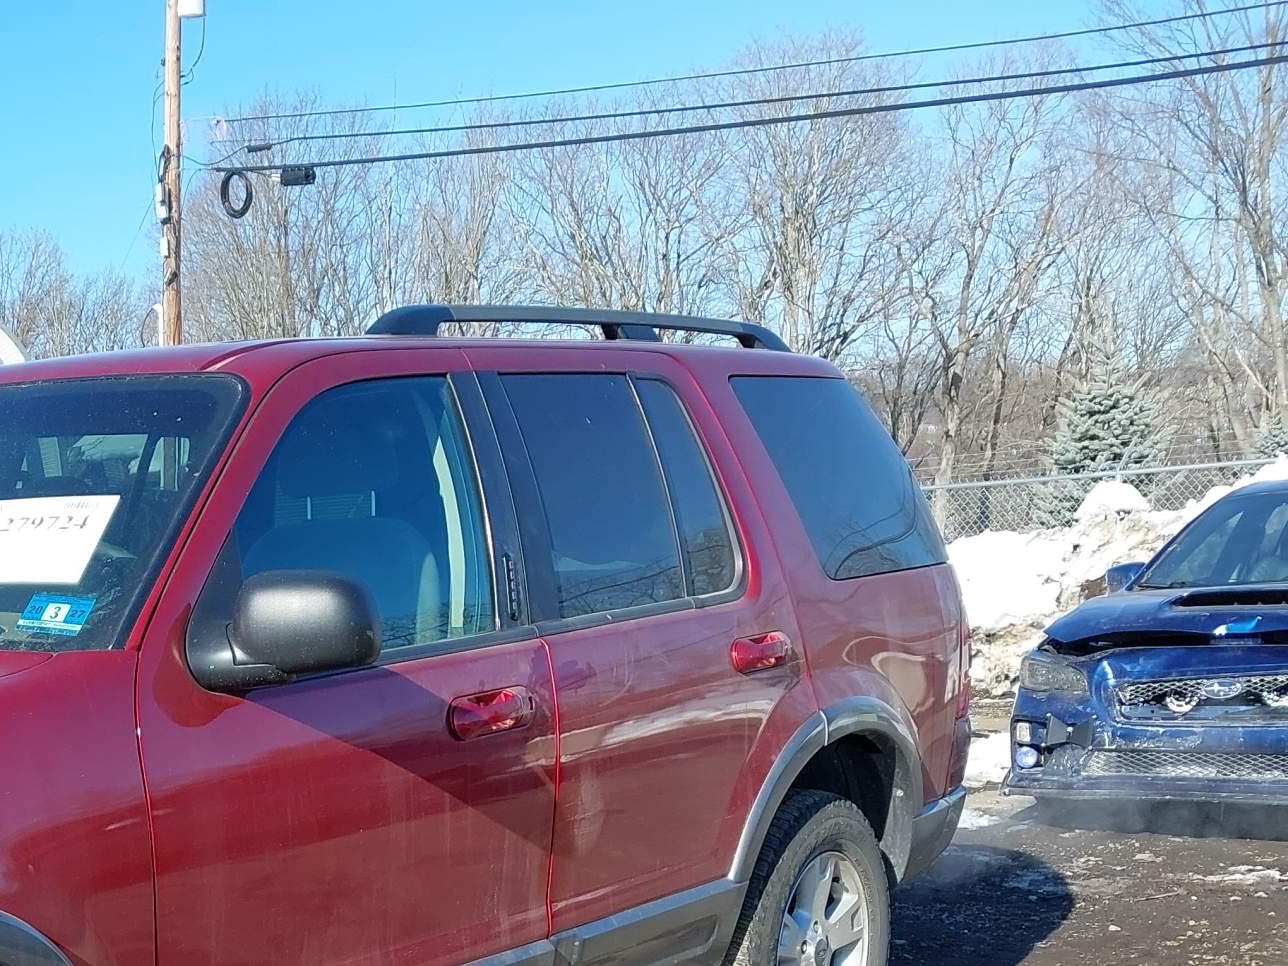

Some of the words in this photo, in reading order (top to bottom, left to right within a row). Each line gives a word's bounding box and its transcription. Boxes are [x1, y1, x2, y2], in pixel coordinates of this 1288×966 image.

[27, 605, 43, 615] 20
[49, 606, 62, 620] 3
[69, 609, 87, 619] 27
